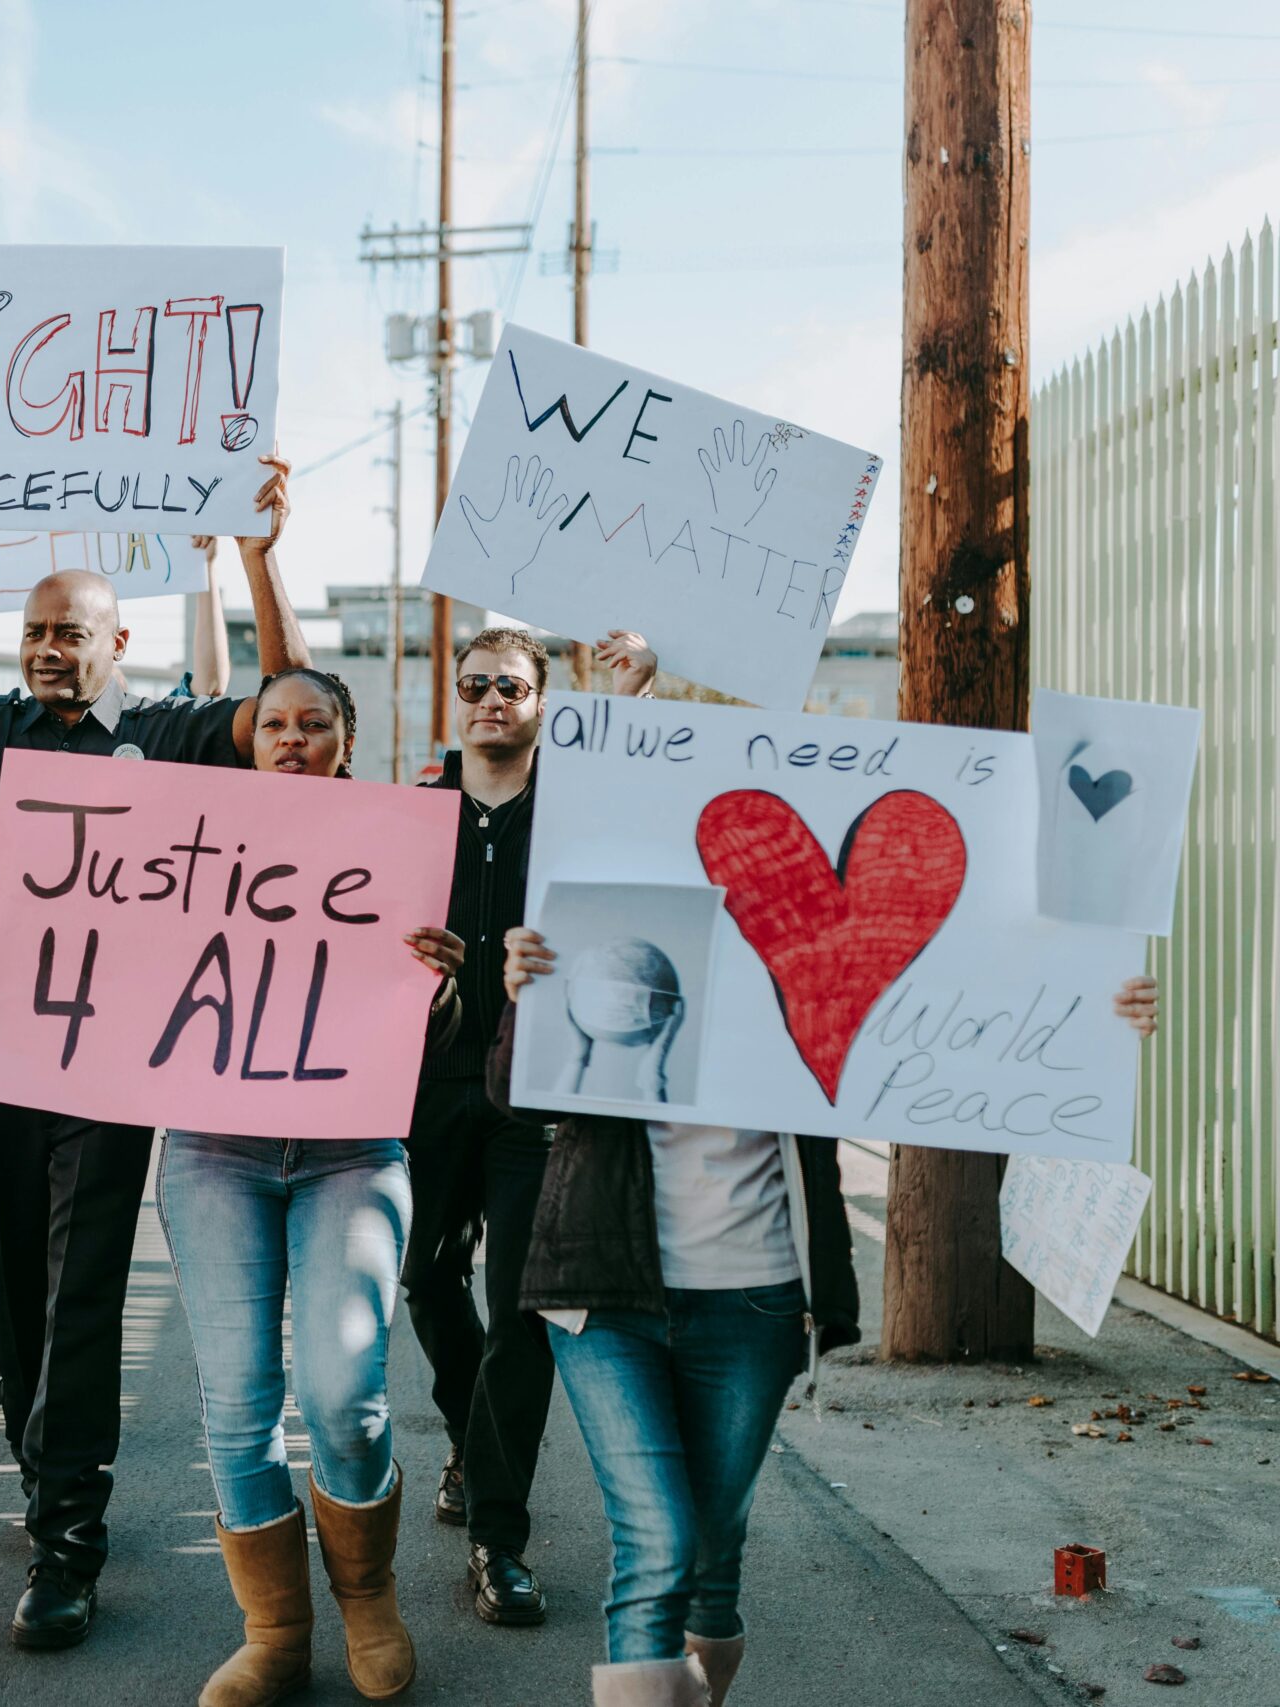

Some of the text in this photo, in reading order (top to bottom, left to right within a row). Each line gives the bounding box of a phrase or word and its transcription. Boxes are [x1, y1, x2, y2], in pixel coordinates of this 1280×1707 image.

[509, 350, 672, 464] WE
[560, 491, 846, 630] MATTER
[551, 699, 998, 785] all we need is
[15, 799, 380, 924] Justice
[34, 926, 348, 1082] 4 ALL
[866, 984, 1085, 1071] World
[864, 1053, 1113, 1142] Peace
